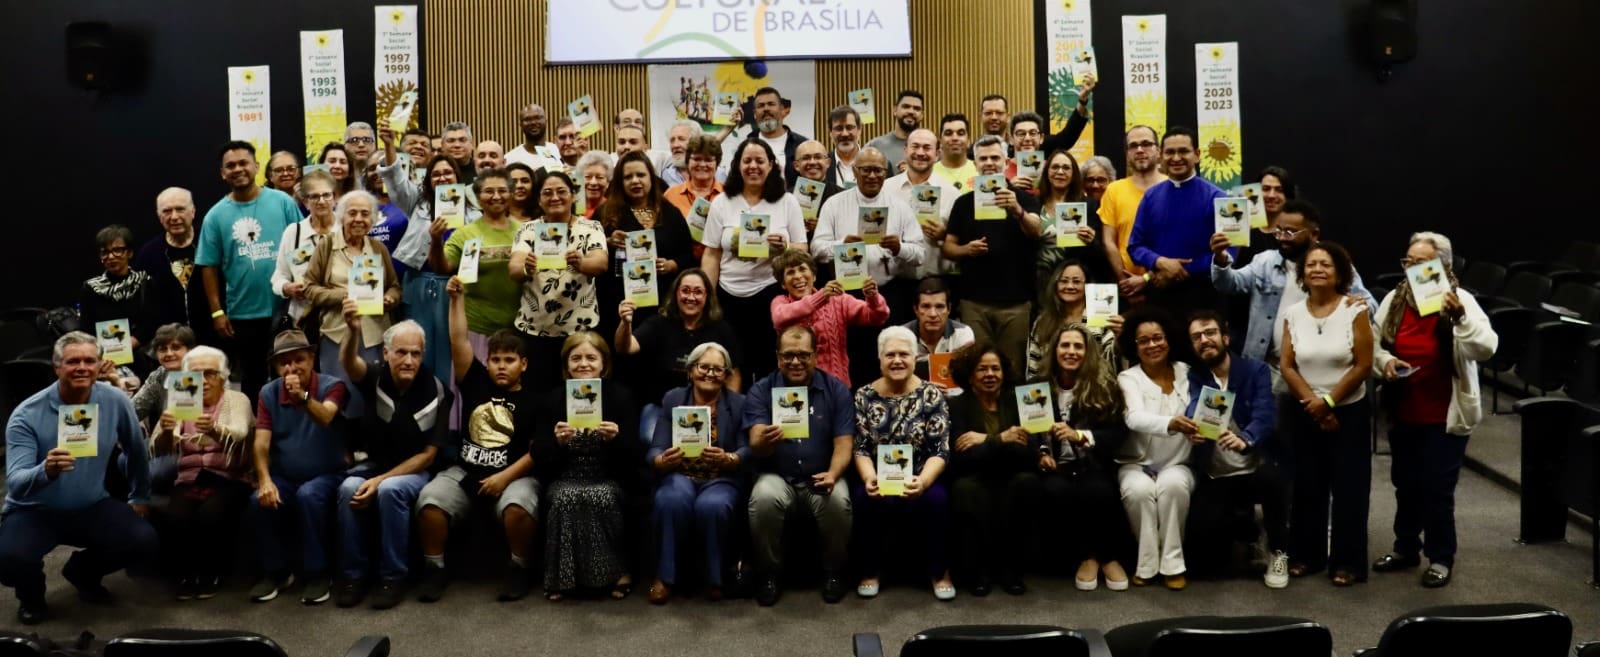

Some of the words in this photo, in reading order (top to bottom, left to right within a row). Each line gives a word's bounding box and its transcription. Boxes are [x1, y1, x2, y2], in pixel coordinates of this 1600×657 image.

[713, 11, 748, 32] DE
[764, 3, 883, 32] BRASÍLIA
[384, 53, 410, 63] 1997
[1055, 52, 1069, 63] 20
[384, 64, 410, 74] 1999
[1130, 62, 1159, 72] 2011
[311, 77, 337, 86] 1993
[1130, 73, 1160, 84] 2015
[312, 87, 337, 97] 1994
[1203, 87, 1233, 97] 2020
[1204, 99, 1233, 110] 2023
[238, 111, 263, 122] 1991
